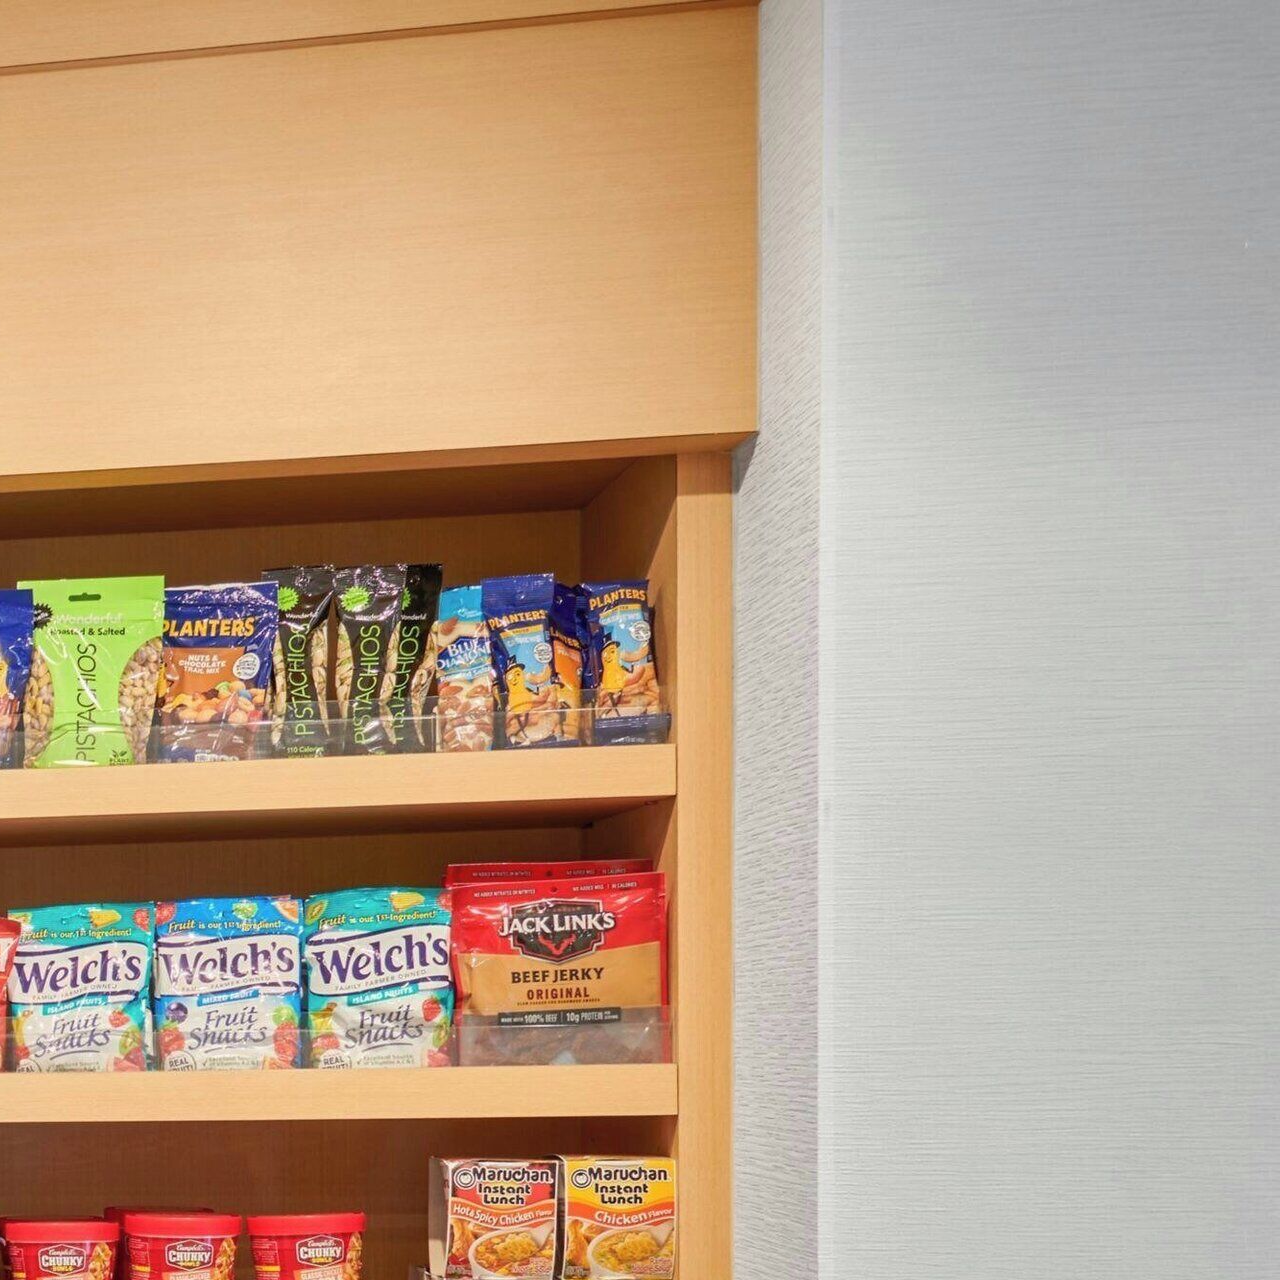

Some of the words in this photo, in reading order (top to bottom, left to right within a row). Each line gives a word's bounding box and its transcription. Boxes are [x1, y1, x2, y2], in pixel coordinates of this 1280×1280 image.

[163, 618, 254, 637] PLANTERS
[77, 643, 97, 762] PISTACHIOS
[320, 915, 346, 928] Fruit
[389, 911, 436, 922] Ingredient!
[499, 915, 552, 936] JACK
[553, 912, 615, 931] LINK'S
[314, 934, 449, 984] Welch's
[14, 949, 140, 993] Welch's
[160, 940, 295, 993] Welch's
[511, 970, 549, 984] BEEF
[552, 967, 604, 983] JERKY
[527, 987, 589, 1000] ORIGINAL
[52, 1013, 99, 1035] Fruit
[473, 1168, 550, 1182] Maruchan
[590, 1167, 667, 1181] Maruchan
[478, 1184, 531, 1194] Instant
[595, 1183, 648, 1194] Instant
[484, 1195, 524, 1205] Lunch
[601, 1194, 642, 1204] Lunch
[500, 1212, 534, 1226] Chicken
[595, 1211, 646, 1226] Chicken
[168, 1250, 211, 1263] CHUNKY
[298, 1246, 342, 1259] CHUNKY
[41, 1256, 83, 1269] CHUNKY
